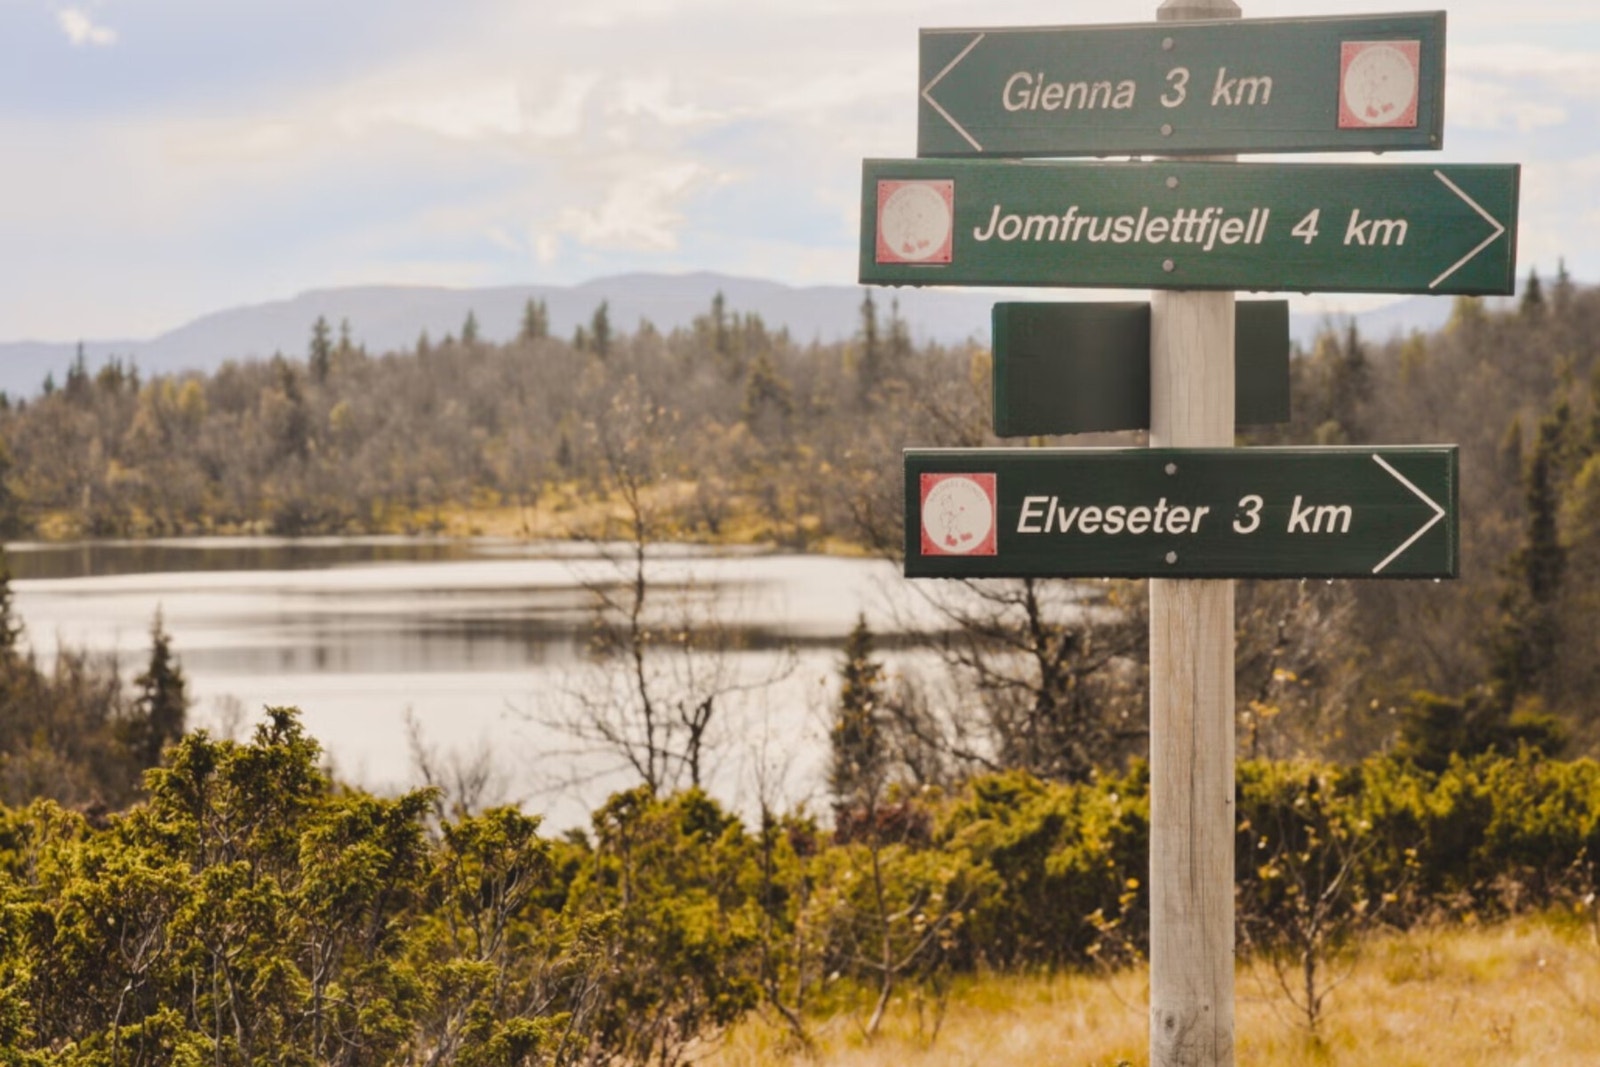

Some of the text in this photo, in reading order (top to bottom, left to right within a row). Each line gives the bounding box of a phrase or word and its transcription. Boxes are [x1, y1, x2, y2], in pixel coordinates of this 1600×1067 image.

[1160, 67, 1190, 108] 3
[1211, 68, 1273, 106] km
[973, 205, 1408, 252] Jomfruslettfjell 4 km
[1017, 494, 1352, 534] Elveseter 3 km
